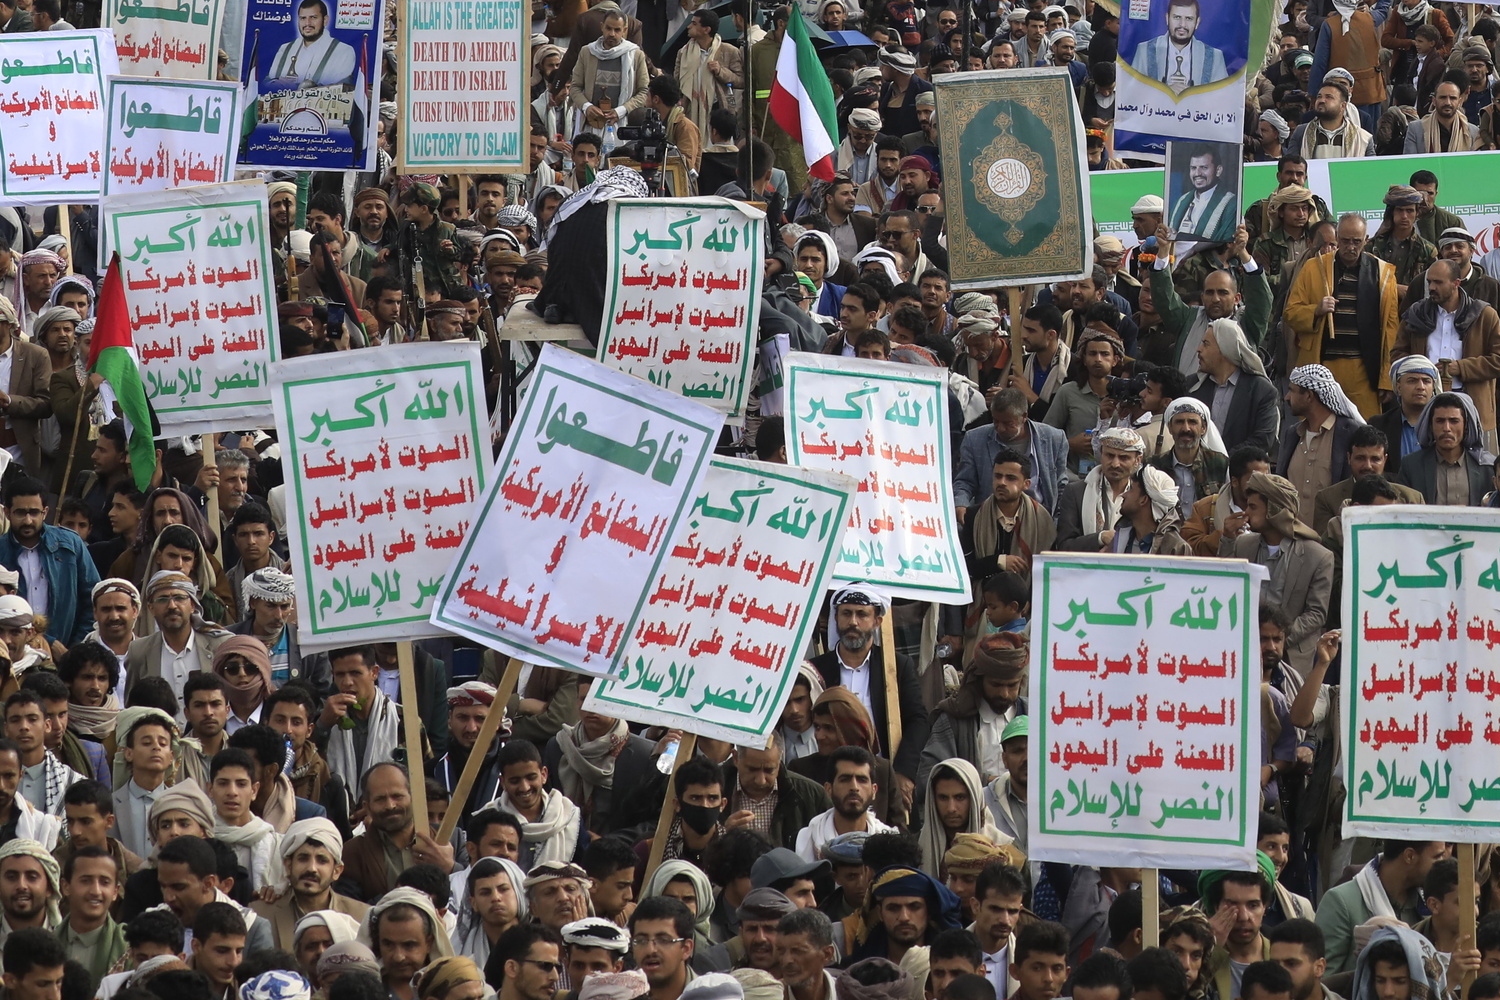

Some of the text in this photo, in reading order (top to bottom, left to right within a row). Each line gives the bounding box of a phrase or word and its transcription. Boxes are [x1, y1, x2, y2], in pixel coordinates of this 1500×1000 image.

[253, 11, 291, 24] فوضناك
[413, 1, 519, 30] ALLAH IS THE GREATEST
[1, 50, 93, 84] قاطعو
[163, 37, 206, 68] البضائع
[414, 42, 516, 62] DEATH TO AMERICA
[264, 89, 350, 104] صادق القول والفعل
[413, 71, 507, 90] DEATH TO ISRAEL
[0, 85, 98, 117] البضائع الأمريكية
[120, 90, 222, 138] قاطعوا
[413, 101, 515, 122] CURSE UPON THE JEWS
[1118, 103, 1236, 125] ألا إن الحق في محمد وآل محمد
[49, 121, 56, 142] و
[413, 132, 517, 156] VICTORY TO ISLAM
[9, 151, 100, 180] لإسرائيلية
[110, 142, 223, 186] البضائع الأمريكية
[534, 385, 688, 487] قاطعوا
[501, 459, 668, 558] البضائع الأمريكية
[545, 535, 568, 574] و
[1362, 534, 1474, 605] أكبر
[457, 564, 625, 663] الإسرائيلية
[1052, 576, 1237, 639] الله أكبر
[1364, 601, 1458, 649] لأمريكا
[1053, 639, 1236, 684] الموت لأمريكا
[1362, 660, 1457, 702] لإسرائيل
[1051, 688, 1235, 730] الموت لإسرائيل
[1360, 712, 1428, 751] اليهود
[1436, 712, 1473, 750] على
[1050, 738, 1234, 774] اللعنة على اليهود
[1050, 778, 1233, 830] النصر للإسلام
[1359, 759, 1452, 814] للإسلام
